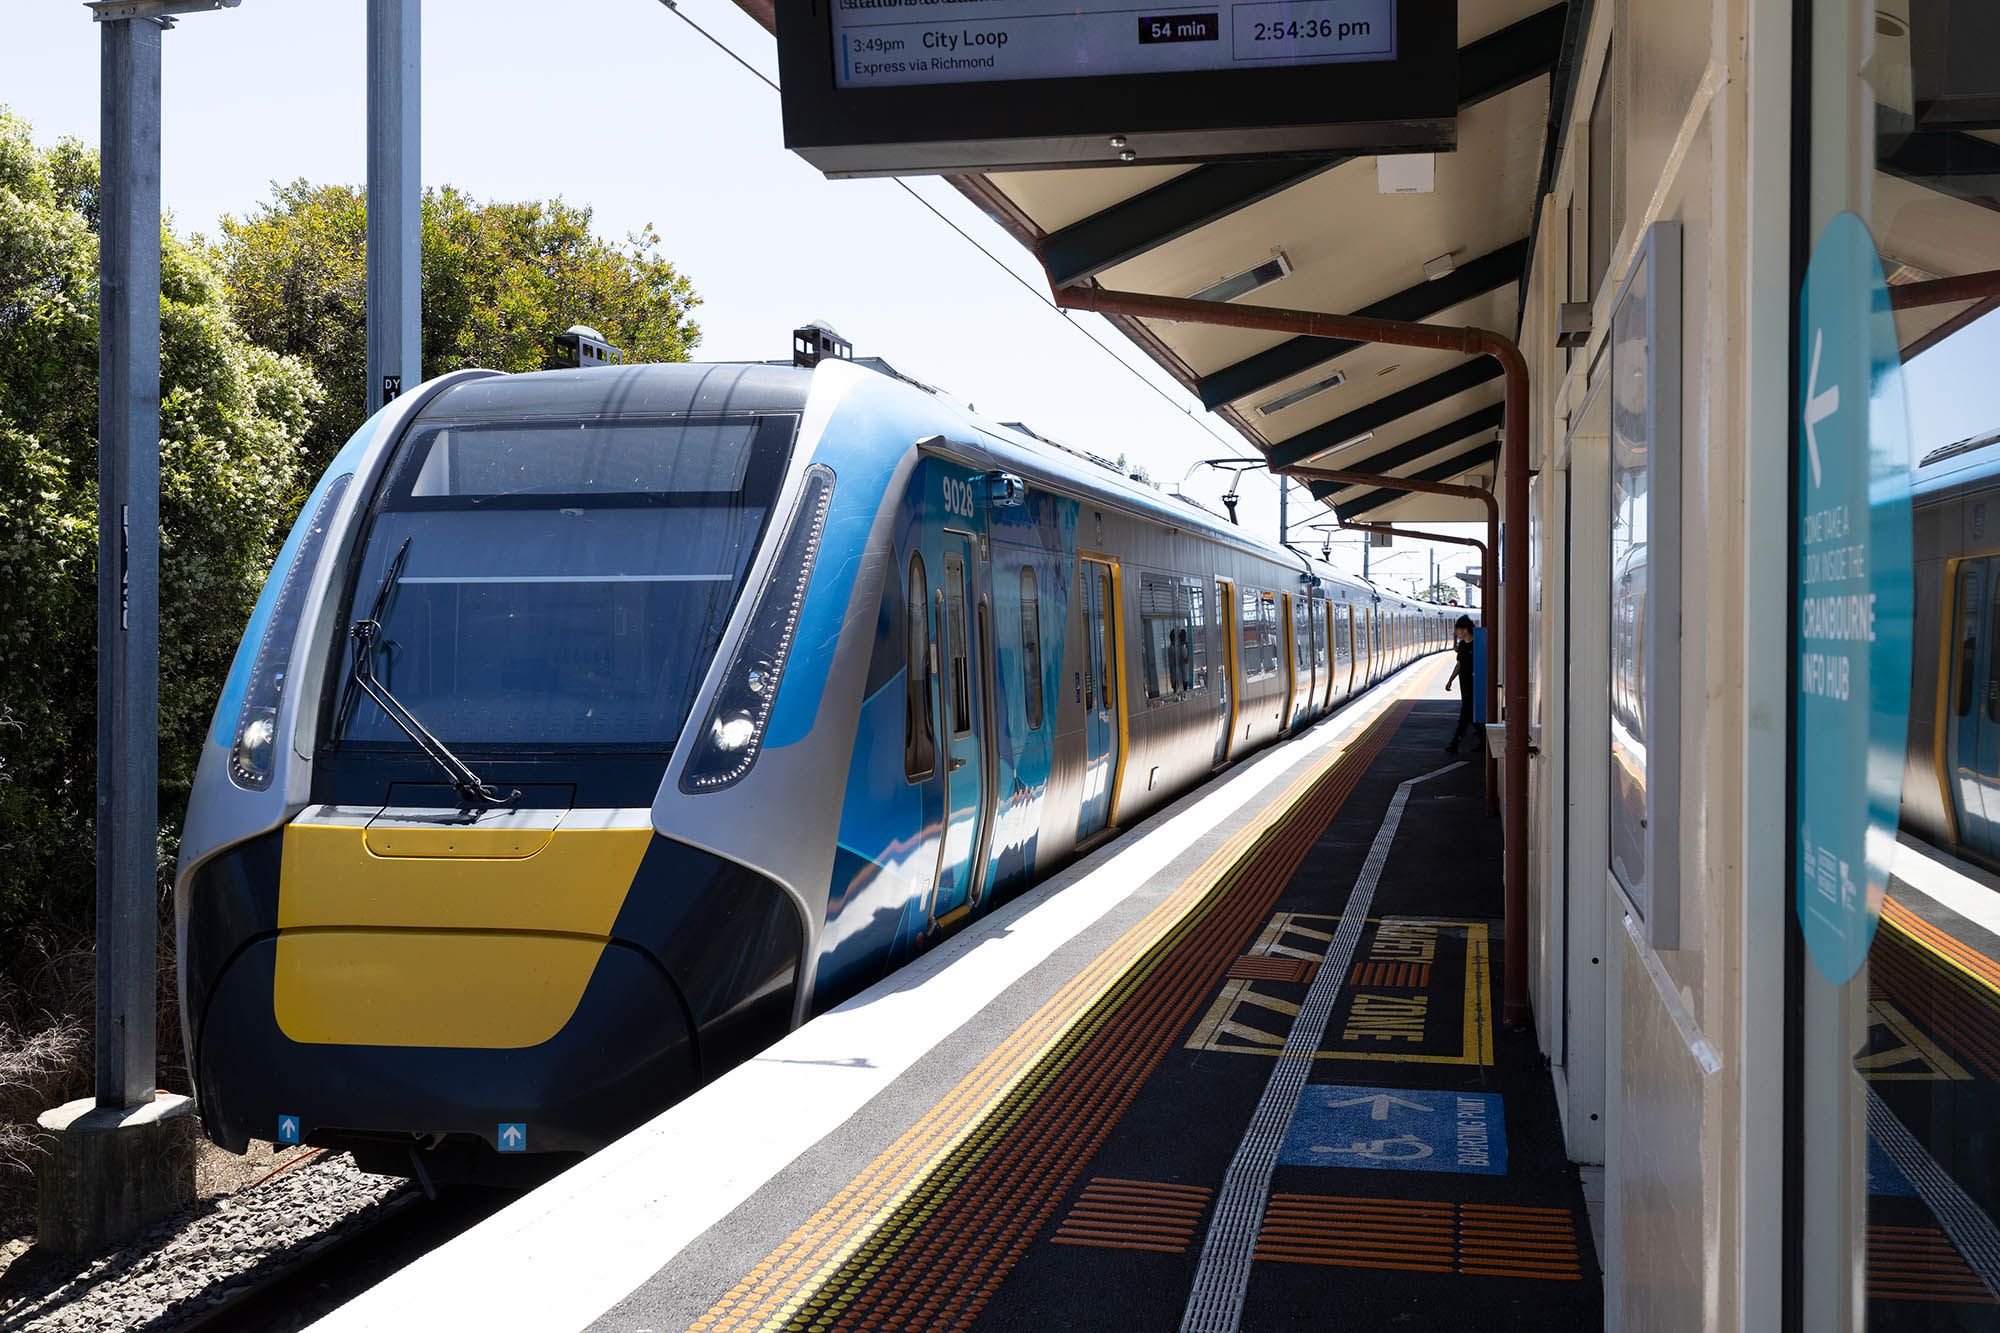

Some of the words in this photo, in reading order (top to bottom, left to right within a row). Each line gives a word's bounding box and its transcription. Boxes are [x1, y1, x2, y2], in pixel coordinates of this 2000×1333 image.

[853, 38, 905, 54] 3:49pm
[922, 31, 959, 51] City
[963, 30, 1008, 49] Loop
[1151, 23, 1171, 38] 54
[1178, 21, 1206, 36] min
[1254, 19, 1332, 41] 2:54:36
[1338, 20, 1371, 40] pm
[854, 60, 906, 76] Express
[909, 58, 928, 72] via
[931, 55, 995, 70] Richmond
[385, 379, 400, 389] DY
[943, 475, 974, 518] 9028
[1803, 512, 1823, 545] COME
[1823, 506, 1843, 540] TAKE
[1843, 504, 1850, 536] A
[1803, 552, 1822, 584] LOOK
[1822, 547, 1847, 582] INSIDE
[1848, 544, 1865, 578] THE
[1802, 593, 1877, 642] CRANBOURNE
[1802, 652, 1825, 695] INFO
[1827, 655, 1850, 700] HUB
[1343, 994, 1429, 1042] ZONE
[1457, 1097, 1487, 1119] POINT
[1457, 1121, 1490, 1167] BOARDING
